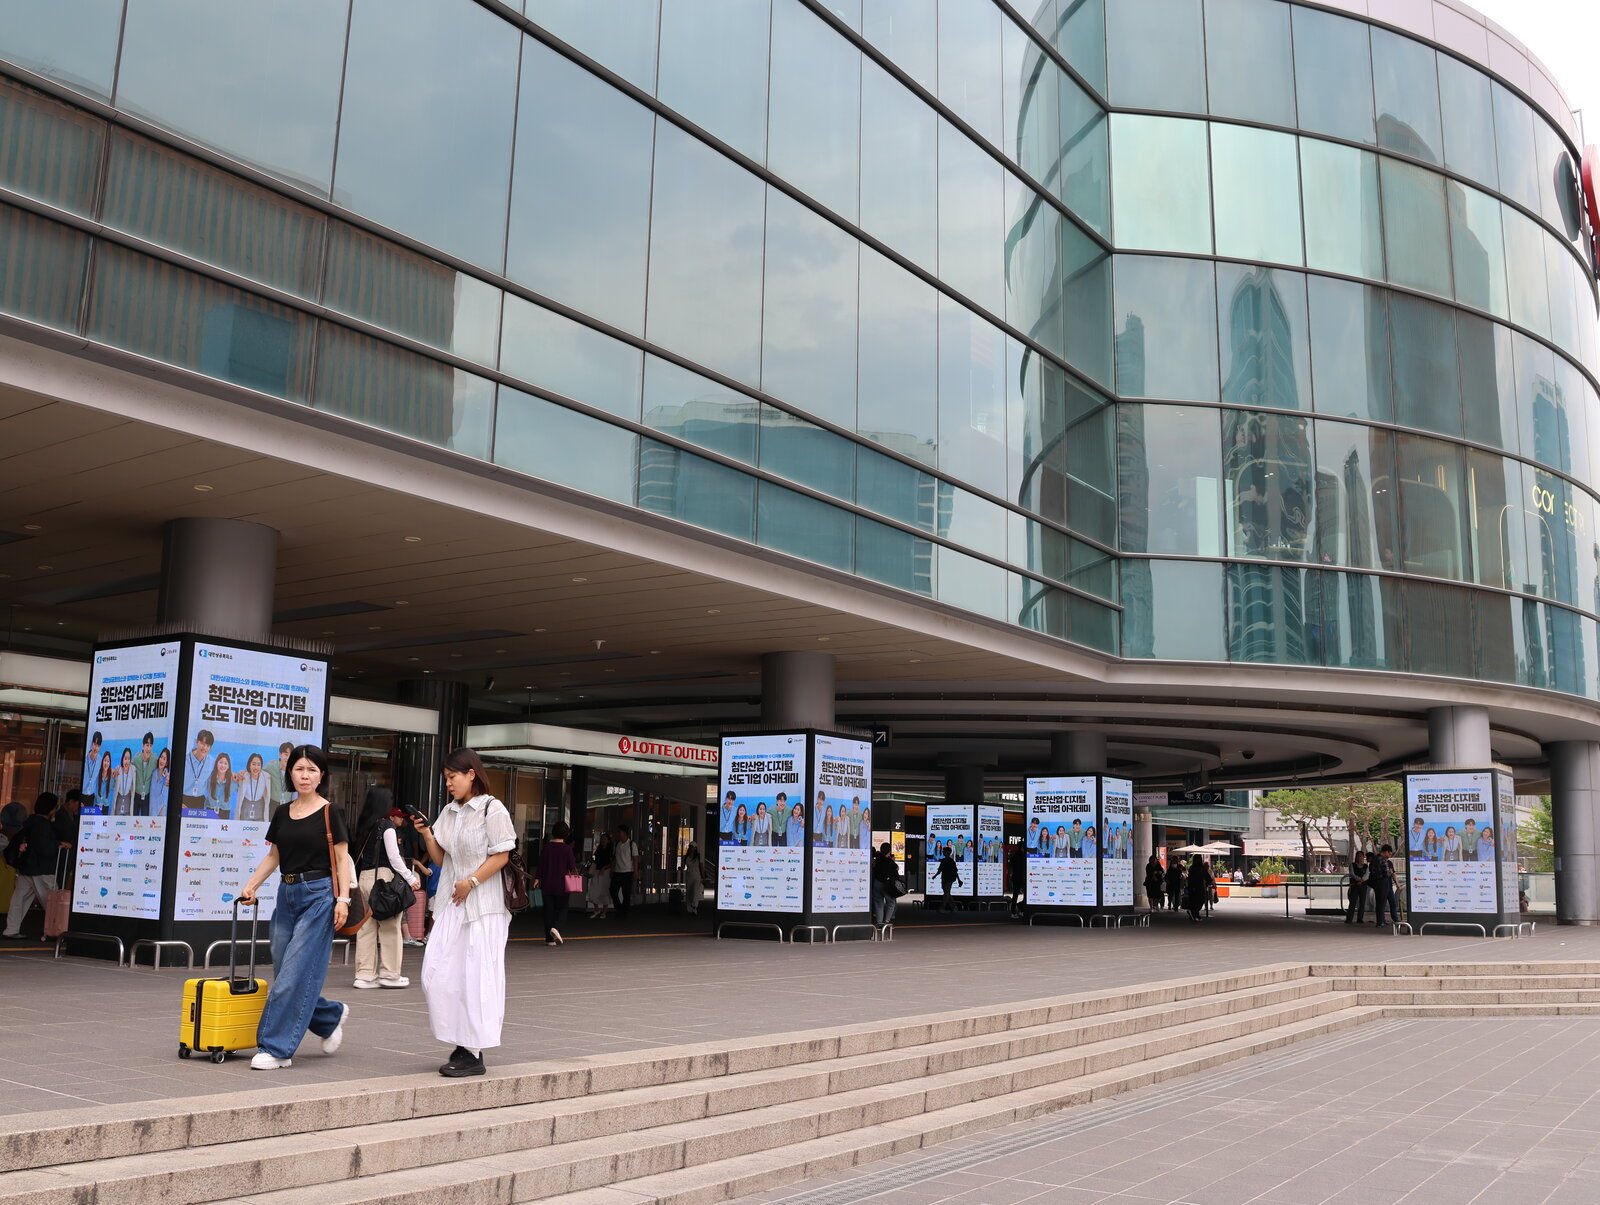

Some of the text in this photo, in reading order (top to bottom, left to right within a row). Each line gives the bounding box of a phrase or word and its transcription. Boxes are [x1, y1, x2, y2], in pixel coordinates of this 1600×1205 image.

[101, 682, 164, 703] 첨단산업·디지털
[208, 684, 307, 712] 첨단산업·디지털
[96, 701, 168, 722] 선도기업 아카데미
[201, 703, 314, 732] 선도기업 아카데미
[633, 741, 718, 762] LOTTE OUTLETS
[731, 760, 793, 772] 첨단산업·디지털
[728, 772, 799, 785] 선도기업 아카데미
[1032, 804, 1091, 813] 선도기업 아카데미
[1415, 803, 1486, 813] 선도기업 아카데미
